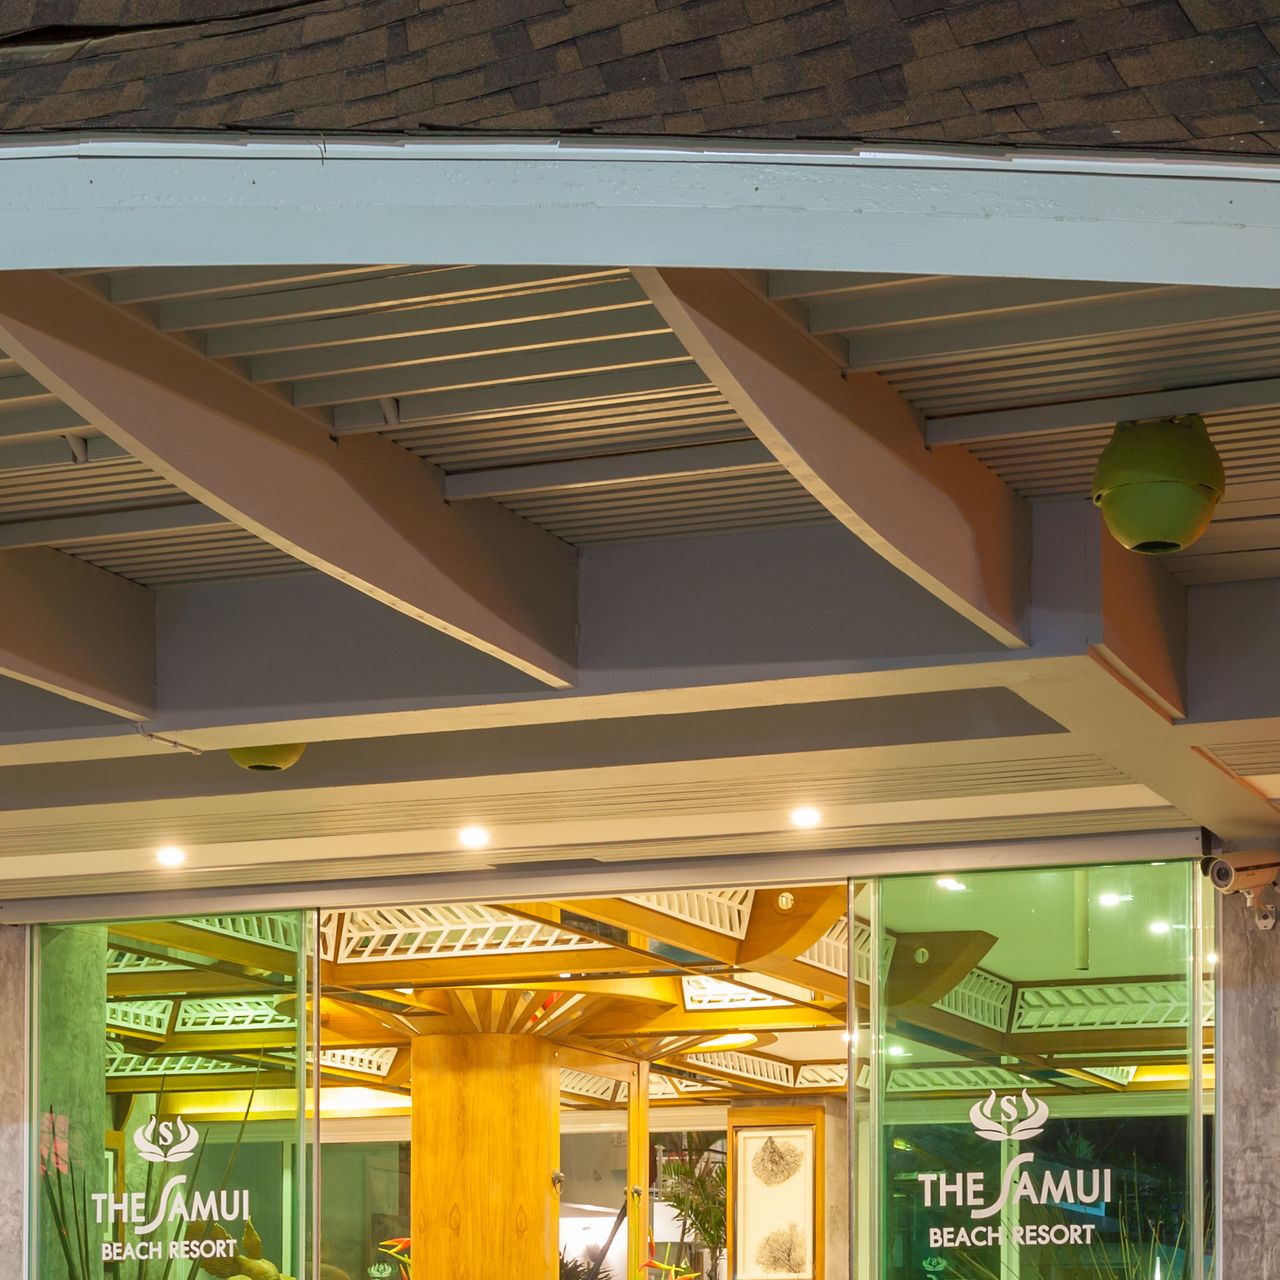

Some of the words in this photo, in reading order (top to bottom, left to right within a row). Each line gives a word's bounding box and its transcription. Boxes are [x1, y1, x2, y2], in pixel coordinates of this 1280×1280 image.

[1000, 1094, 1018, 1122] S
[159, 1121, 173, 1146] S
[918, 1171, 985, 1207] THE
[971, 1152, 1111, 1219] SAMUI
[91, 1192, 146, 1224] THE
[134, 1174, 249, 1235] SAMUI
[929, 1225, 1002, 1249] BEACH
[1012, 1224, 1095, 1246] RESORT
[101, 1241, 162, 1261] BEACH
[170, 1239, 237, 1259] RESORT
